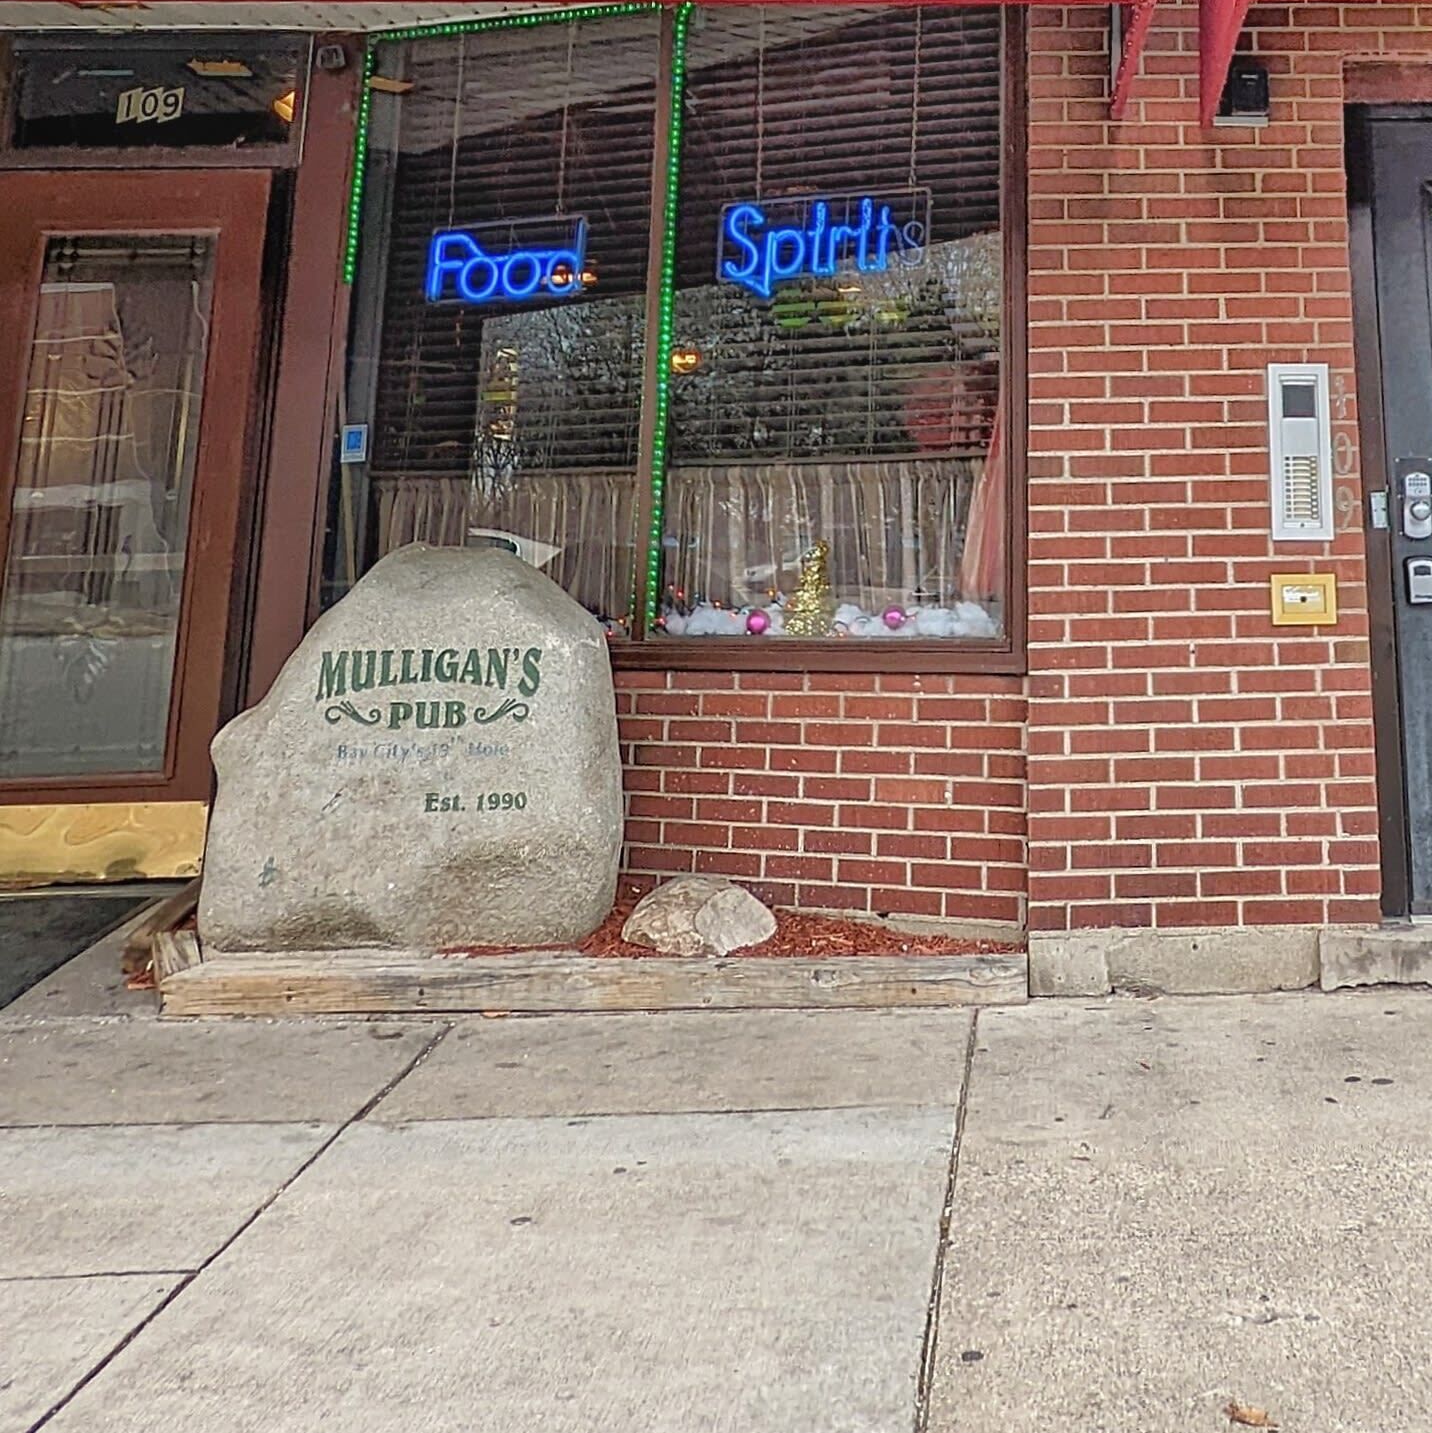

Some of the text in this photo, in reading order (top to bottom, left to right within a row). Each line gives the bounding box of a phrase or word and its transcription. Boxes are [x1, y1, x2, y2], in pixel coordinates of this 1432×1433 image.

[125, 92, 180, 117] 109
[427, 218, 588, 301] Food
[724, 197, 924, 297] Spirits
[315, 647, 543, 702] MULLIGAN'S
[387, 700, 467, 730] PUB
[423, 791, 527, 813] Est. 1990
